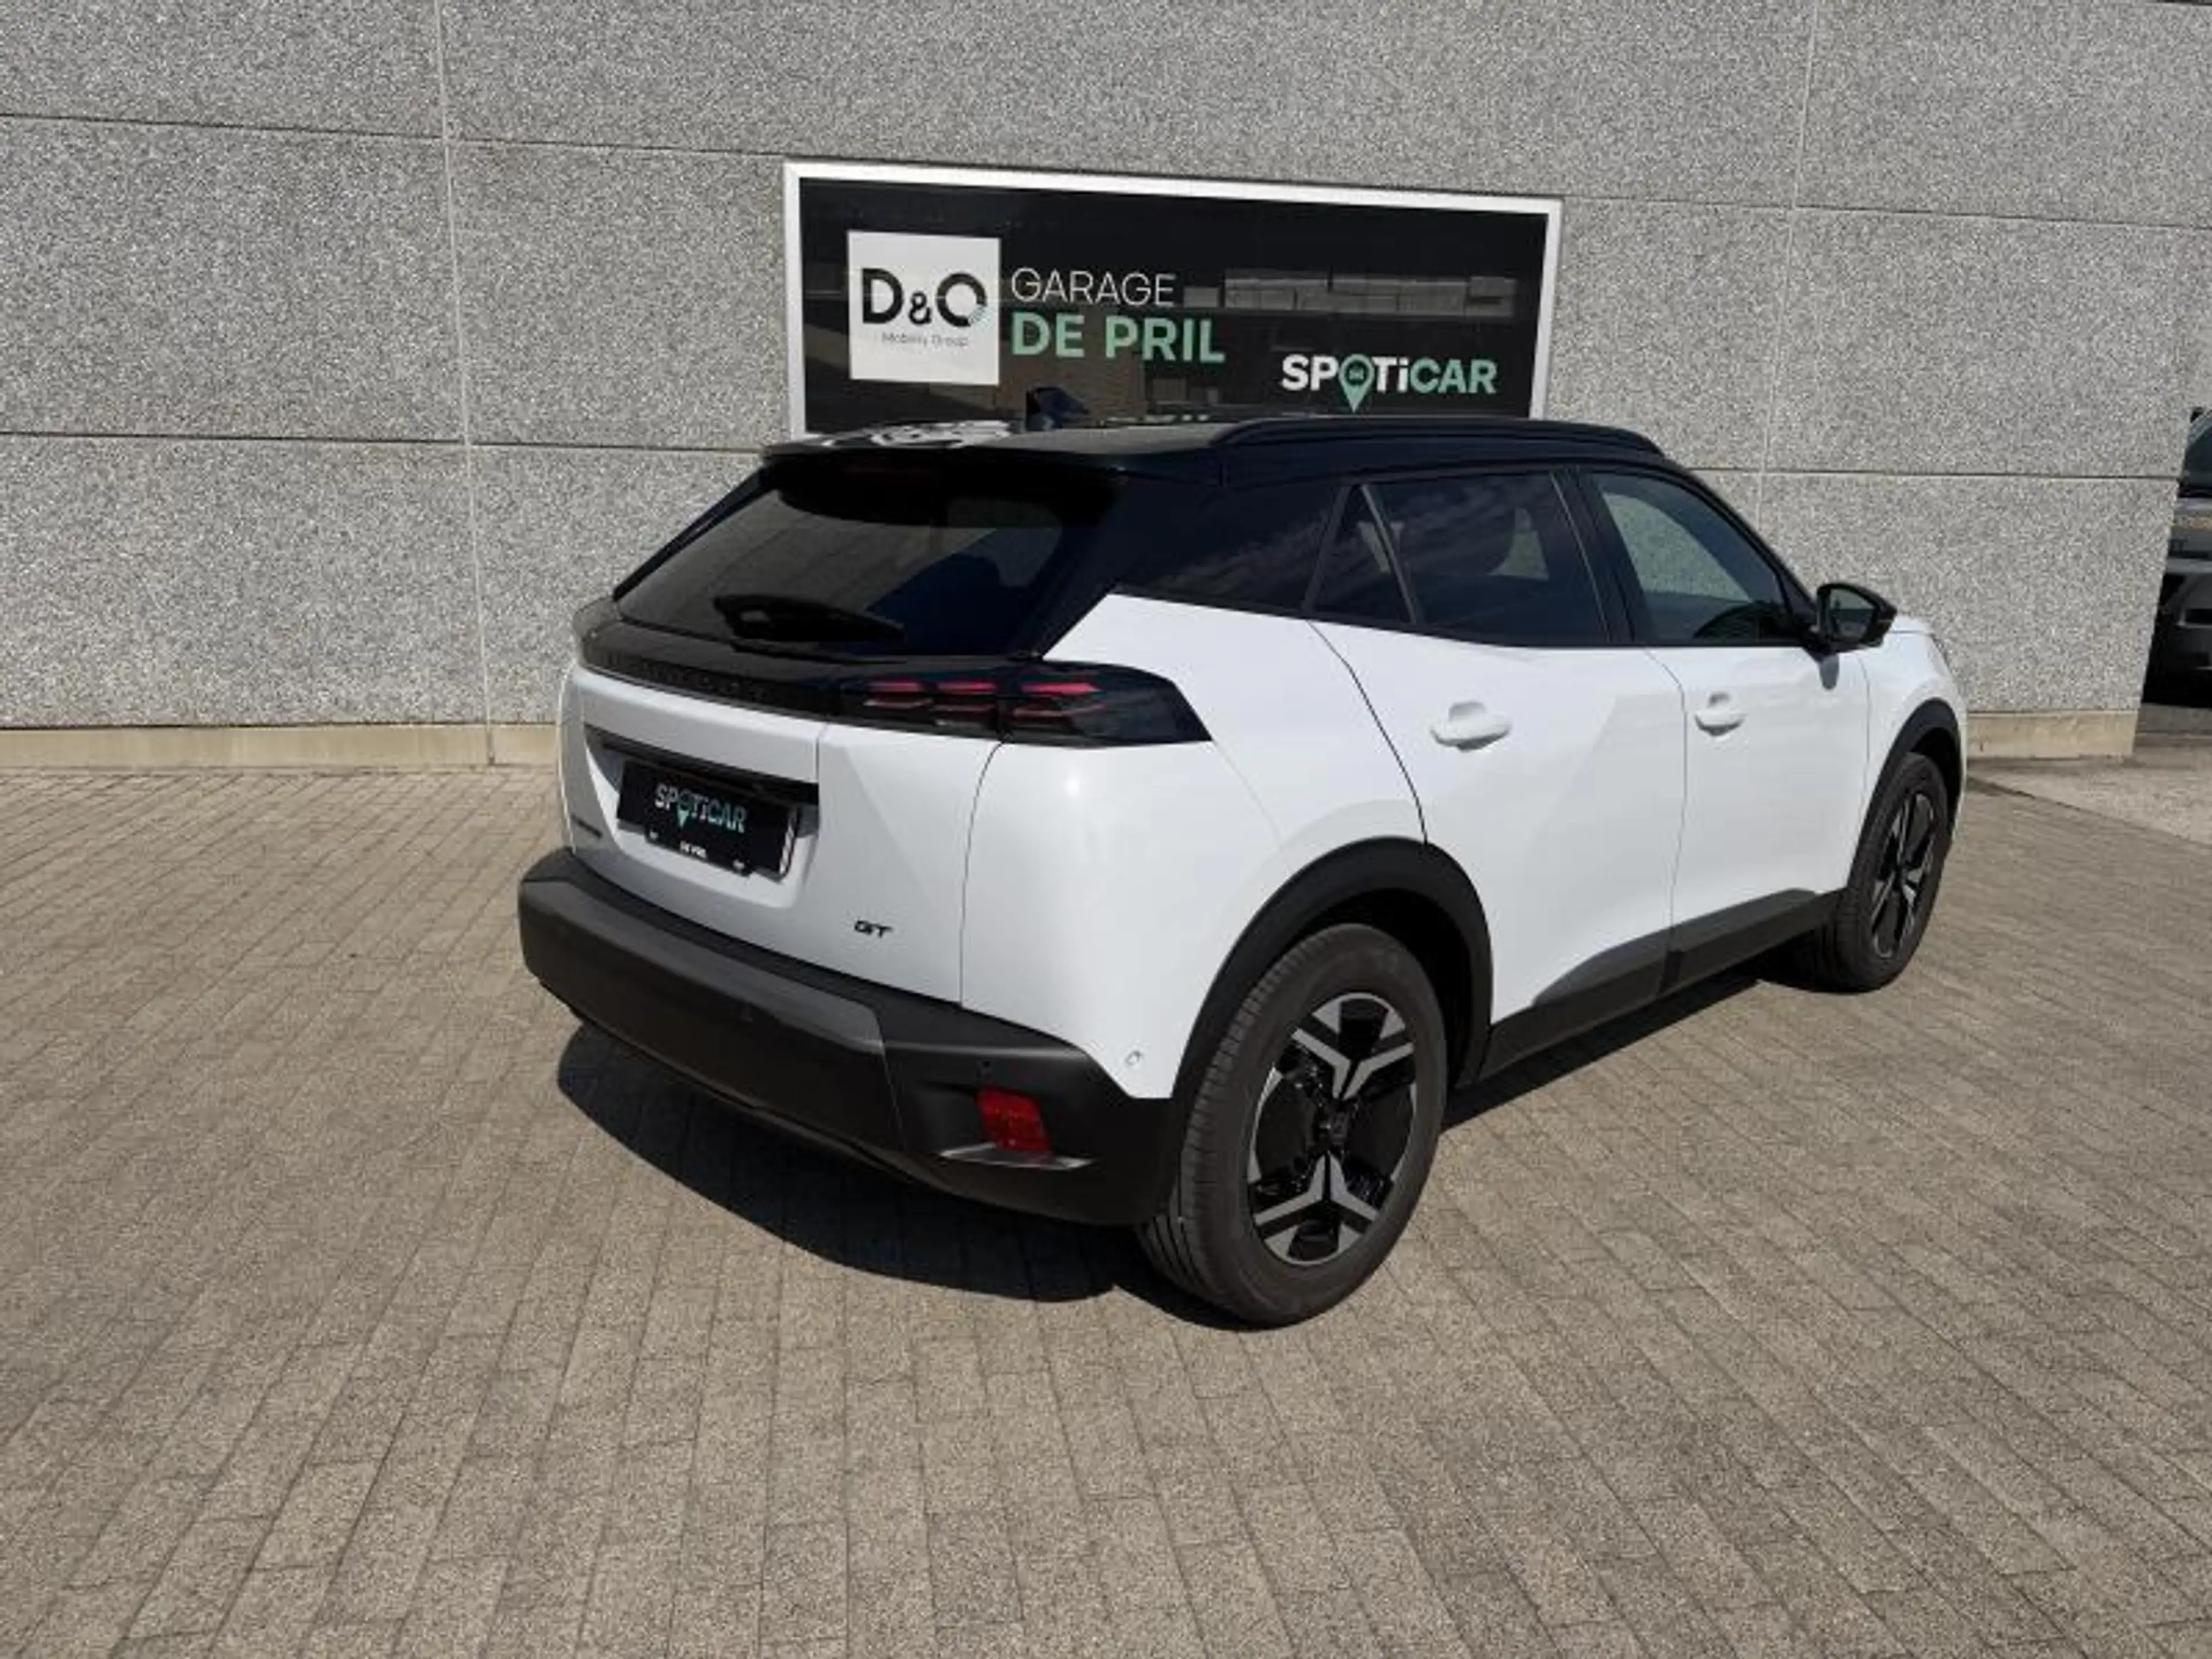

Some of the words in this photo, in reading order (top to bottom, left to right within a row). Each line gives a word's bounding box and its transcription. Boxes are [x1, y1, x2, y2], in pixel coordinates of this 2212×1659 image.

[1012, 267, 1176, 307] GARAGE
[1012, 312, 1085, 358] DE
[1105, 315, 1226, 363] PRIL
[854, 920, 894, 939] GT
